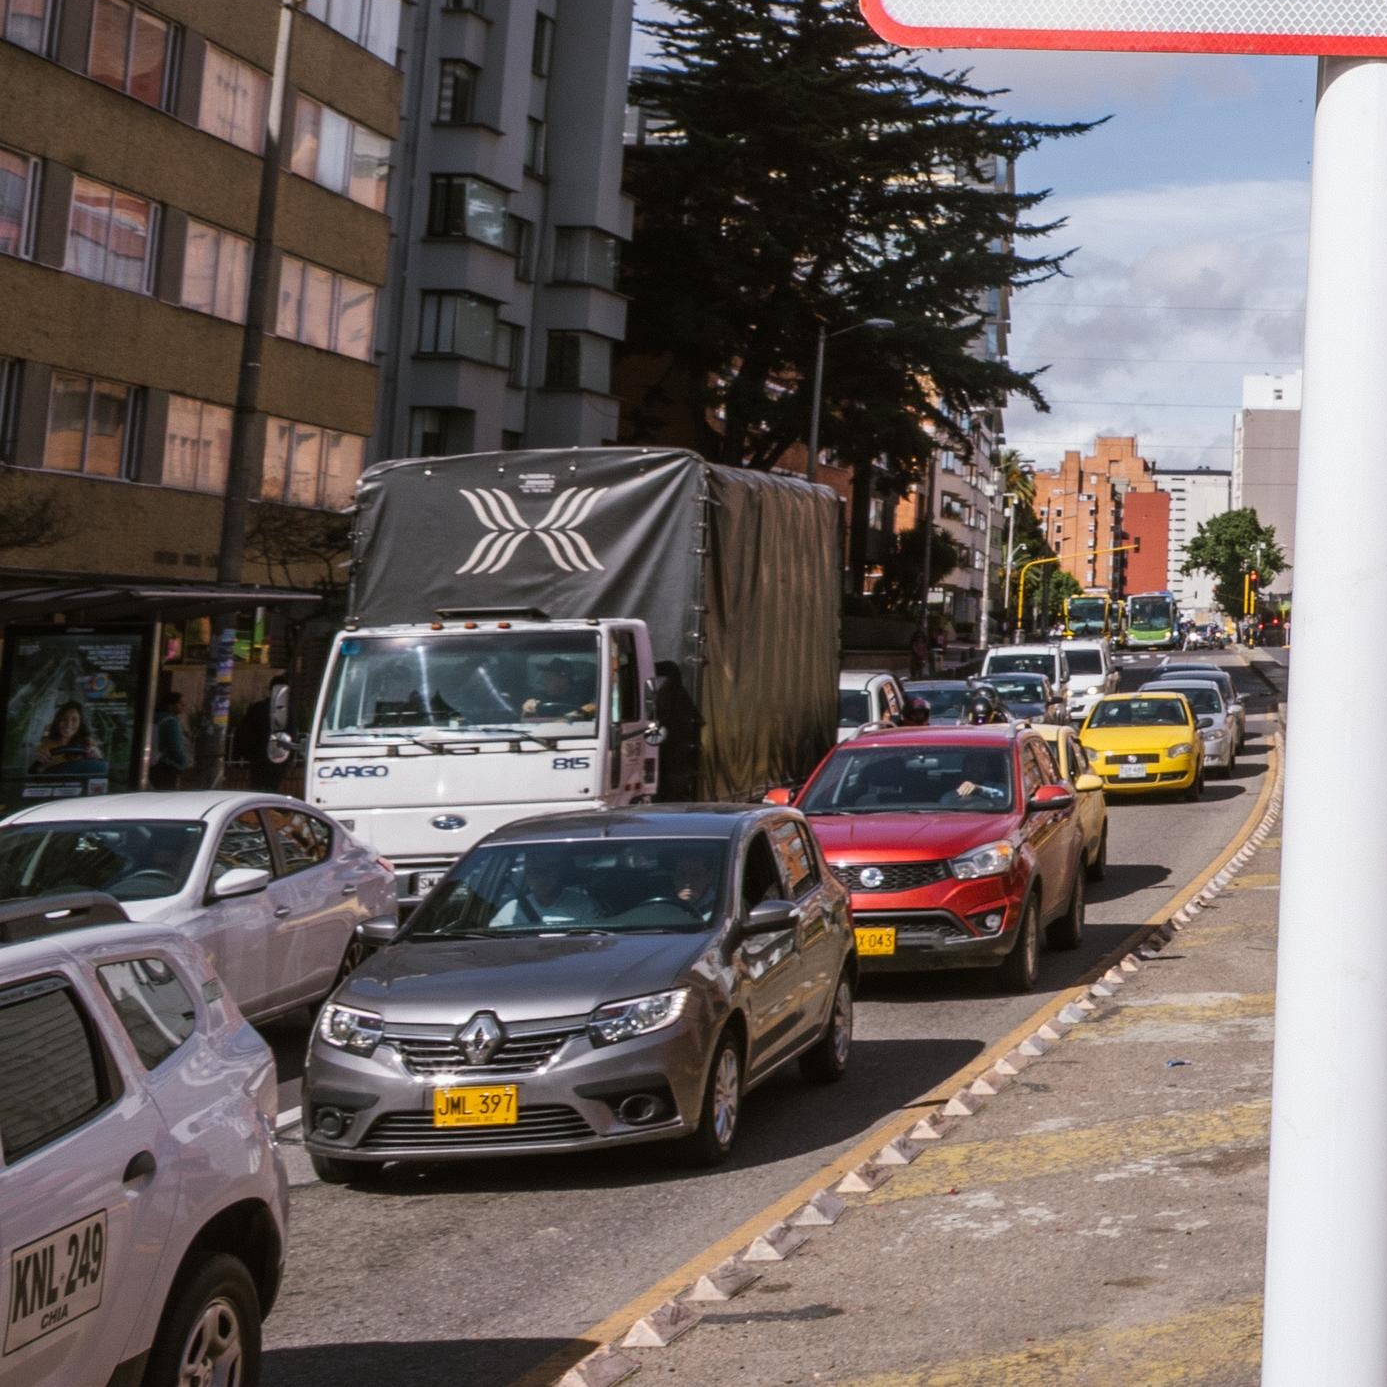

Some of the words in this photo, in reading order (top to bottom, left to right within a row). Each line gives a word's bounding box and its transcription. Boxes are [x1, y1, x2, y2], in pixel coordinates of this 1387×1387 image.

[317, 764, 389, 779] CARGO
[552, 757, 590, 770] 815
[868, 933, 893, 948] 043
[438, 1095, 473, 1115] JML
[479, 1093, 514, 1114] 397
[12, 1244, 59, 1324] KNL
[63, 1222, 104, 1298] 249
